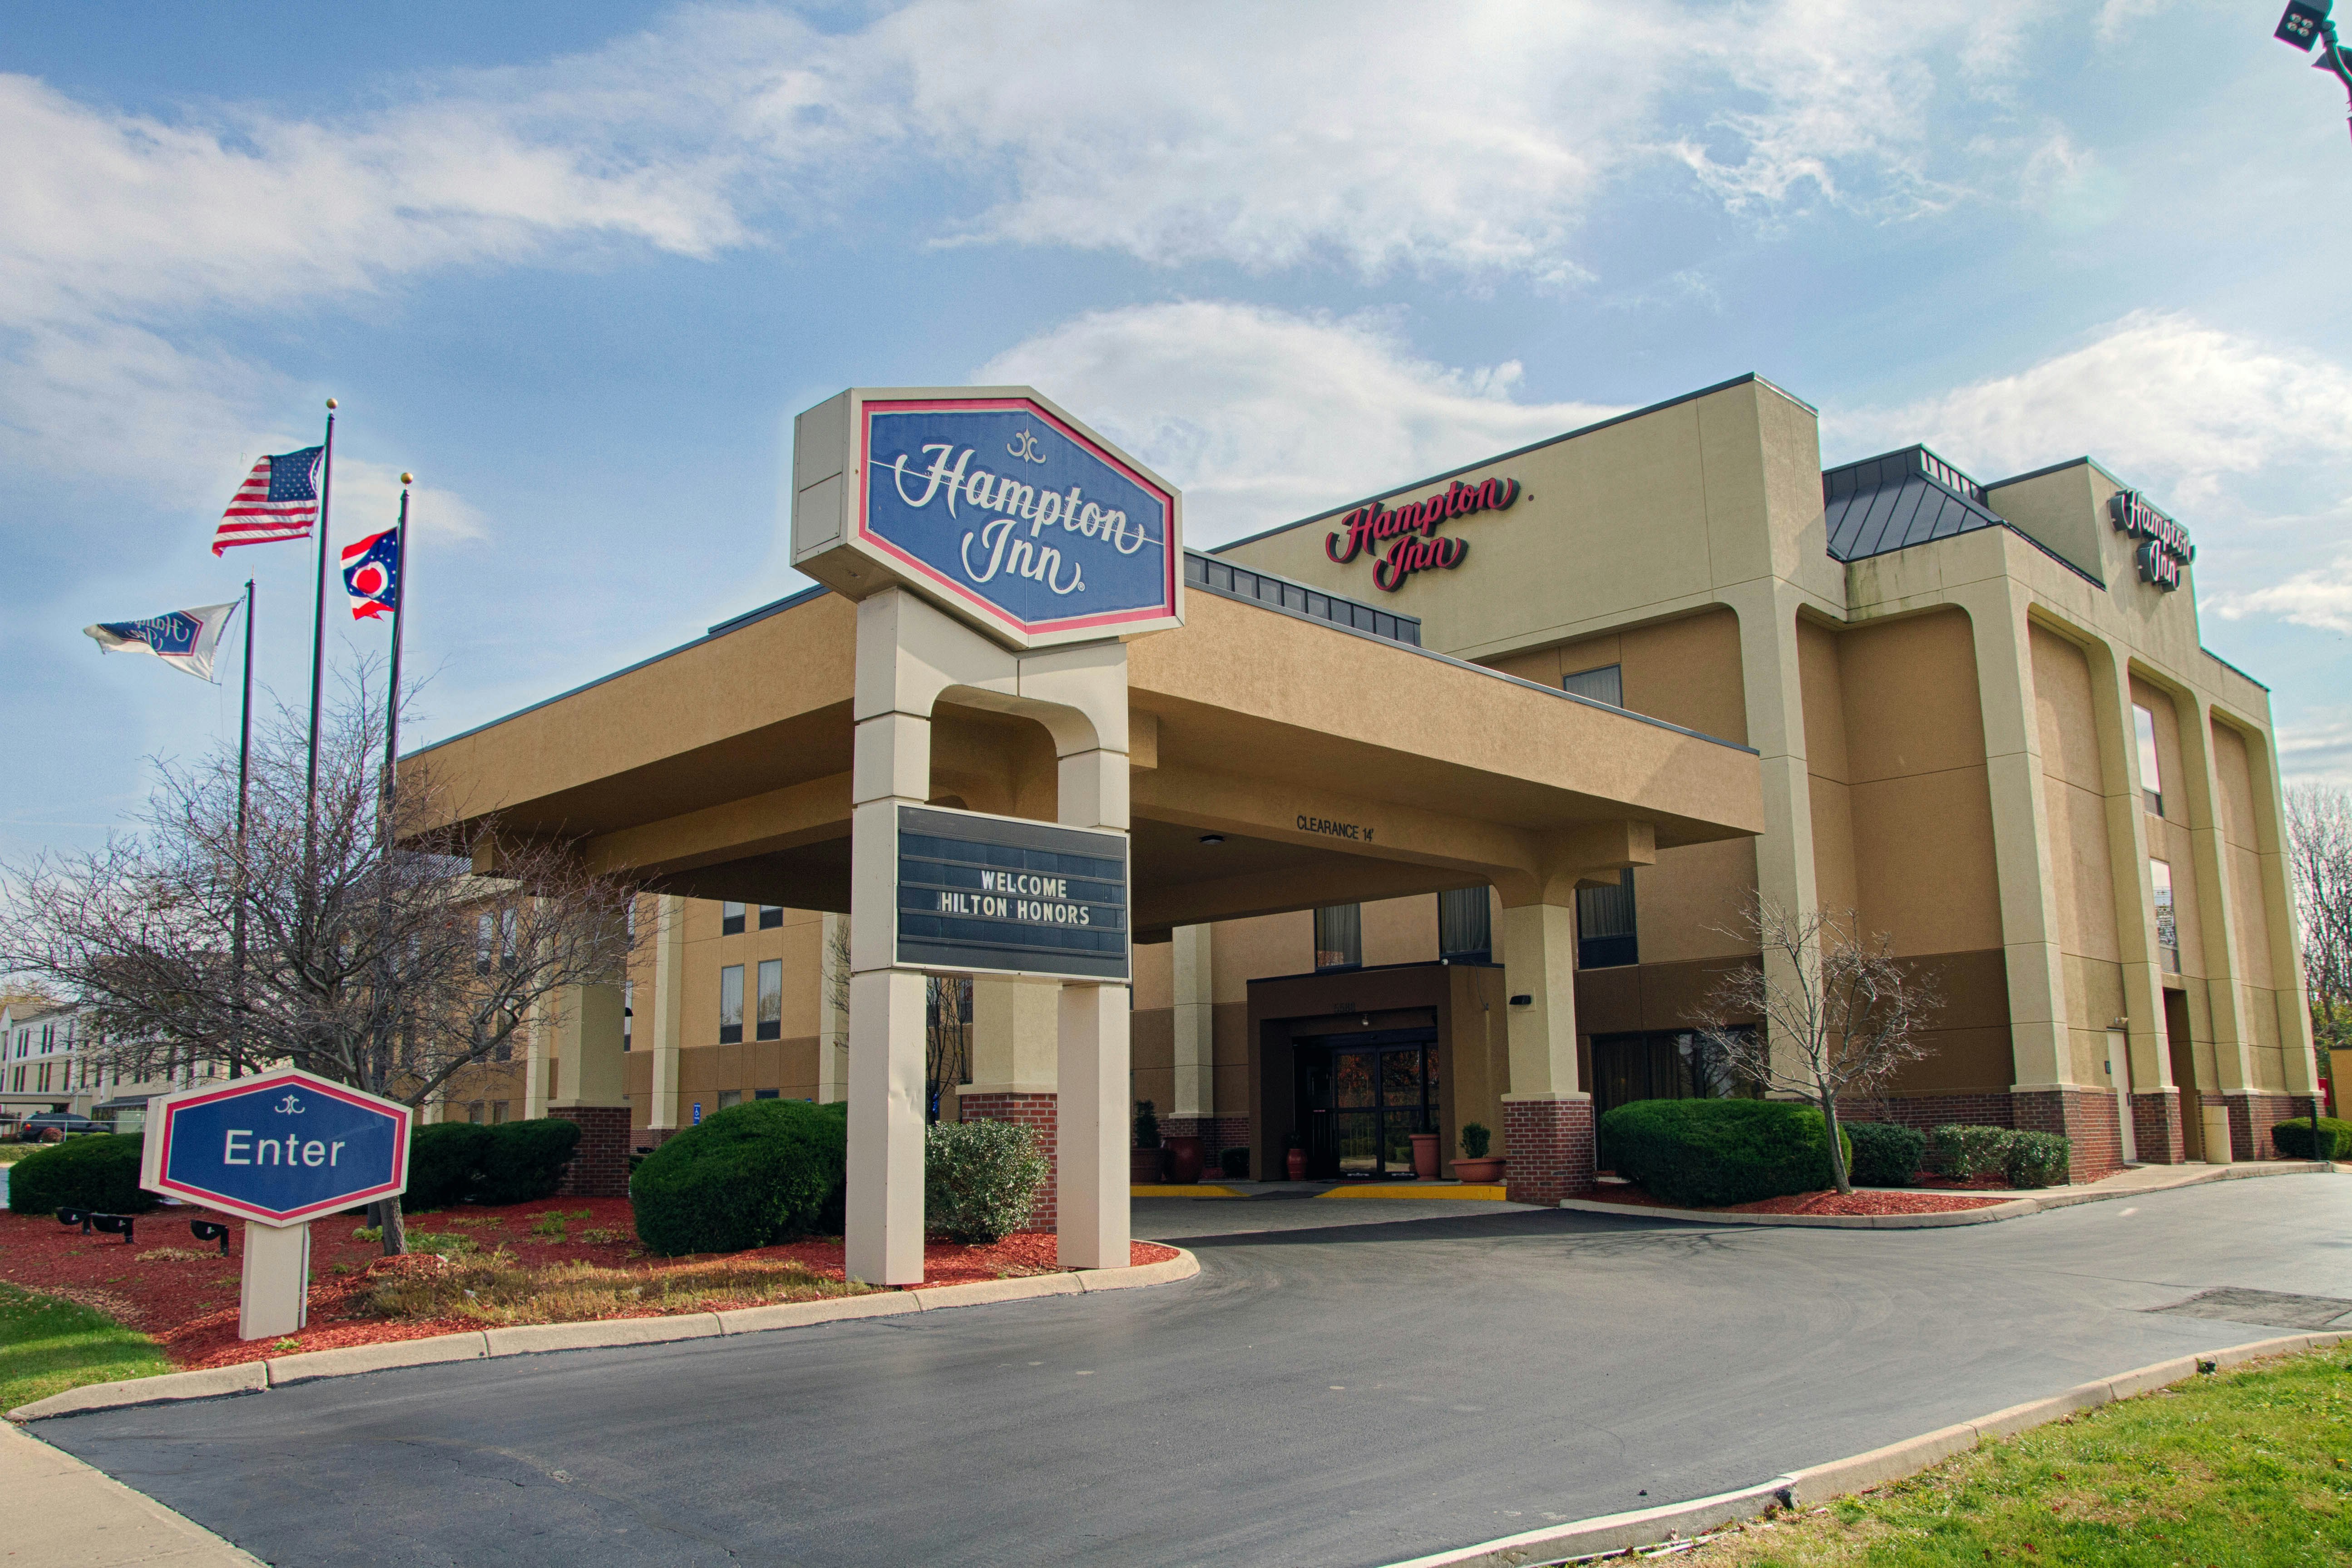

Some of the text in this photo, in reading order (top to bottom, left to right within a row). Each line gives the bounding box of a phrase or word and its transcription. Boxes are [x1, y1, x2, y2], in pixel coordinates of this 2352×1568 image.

[895, 444, 1144, 555] Hampton
[1325, 478, 1519, 564] Hampton
[2114, 489, 2196, 565] Hampton
[962, 519, 1081, 594] Inn
[1373, 535, 1468, 592] Inn
[2141, 540, 2180, 589] Inn
[1297, 815, 1374, 842] CLEARANCE 14'
[941, 892, 1090, 925] HILTON HONORS
[981, 870, 1067, 898] WELCOME
[224, 1129, 345, 1167] Enter
